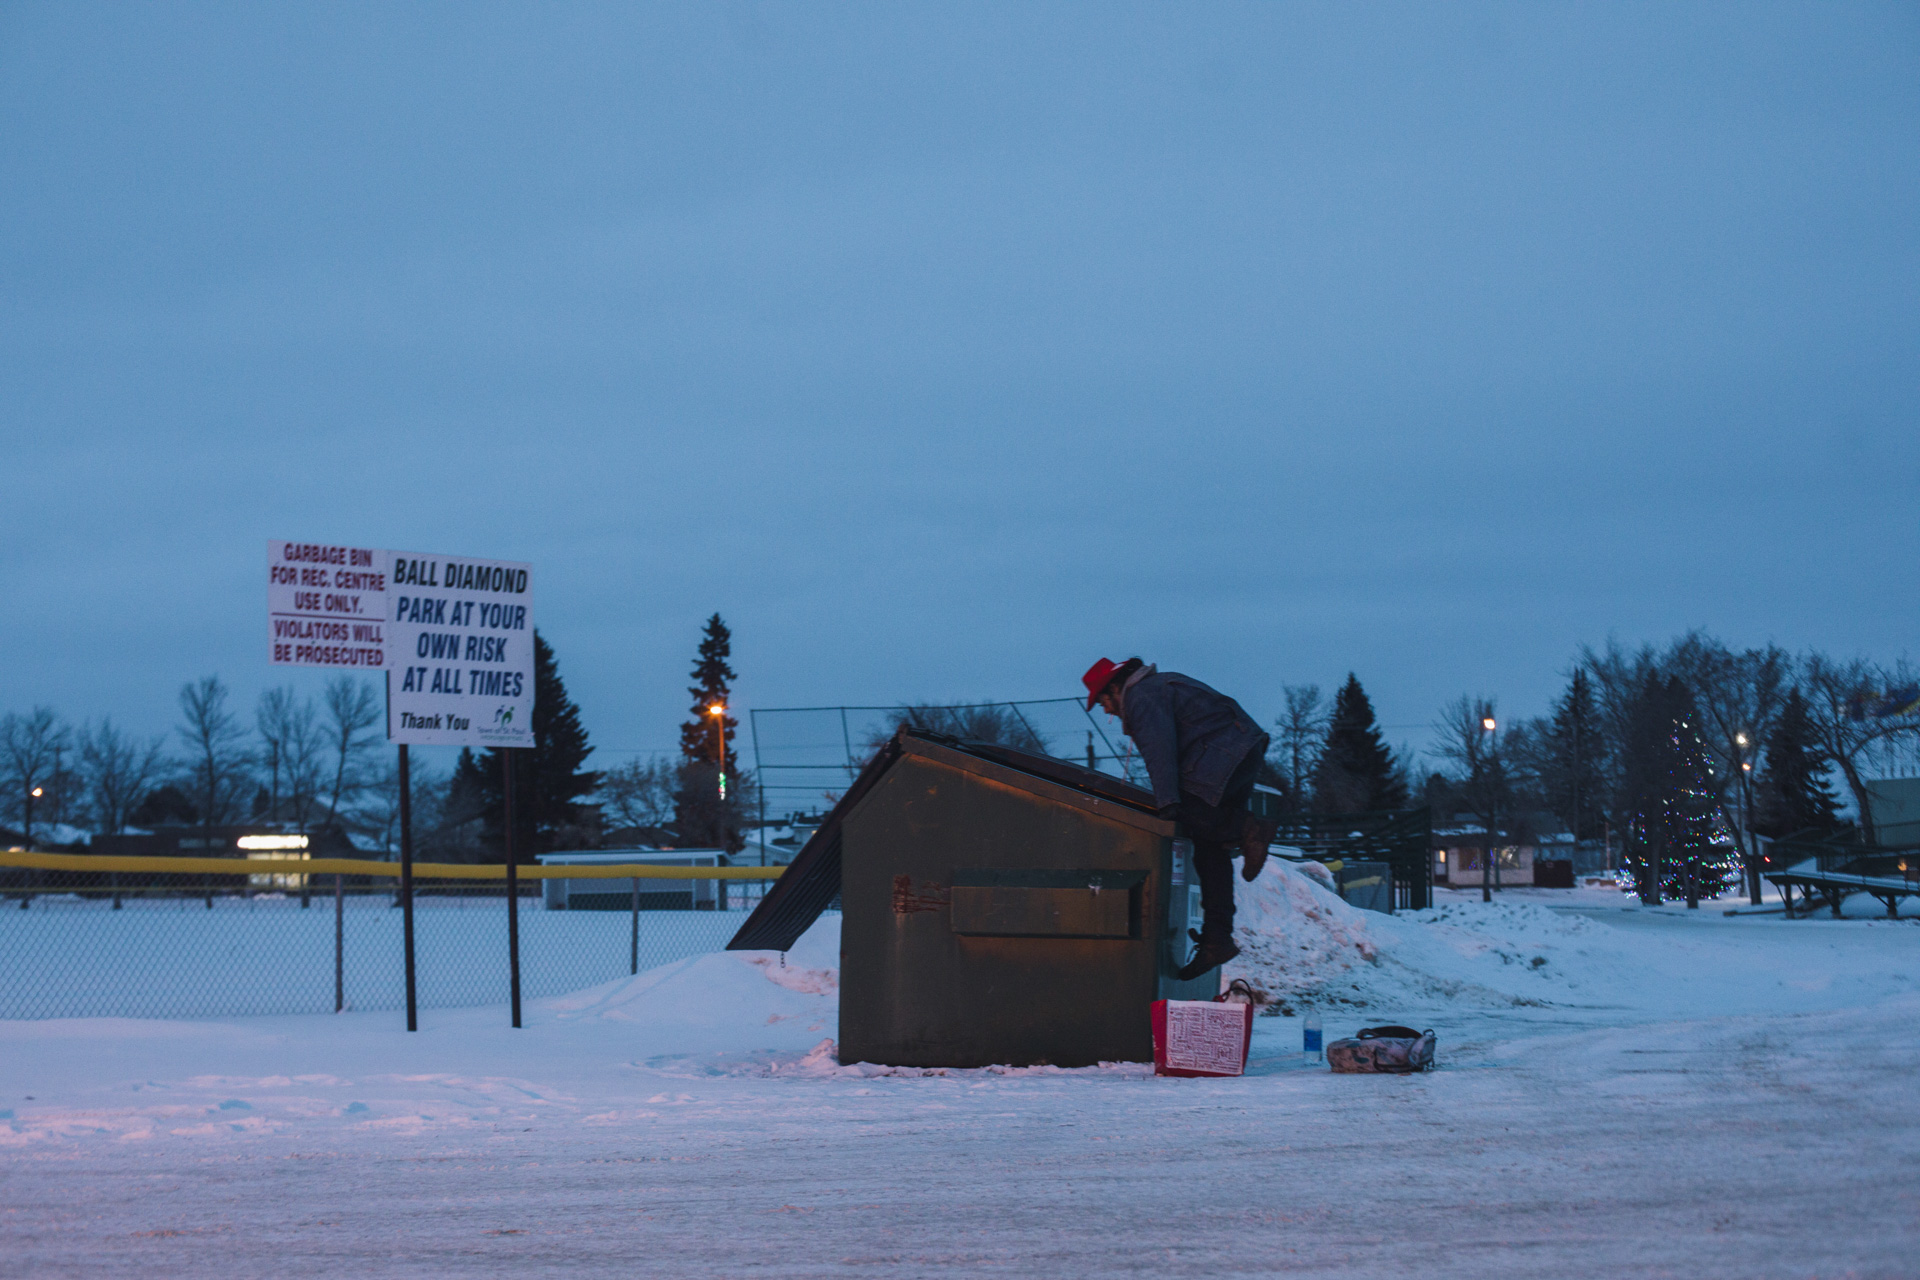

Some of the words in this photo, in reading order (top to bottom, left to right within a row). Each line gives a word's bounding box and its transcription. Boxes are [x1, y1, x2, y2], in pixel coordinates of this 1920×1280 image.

[284, 543, 346, 565] GARBAGE
[350, 549, 372, 567] BIN
[271, 566, 298, 585] FOR
[301, 569, 331, 588] REC.
[335, 571, 385, 591] CENTRE
[394, 559, 438, 586] BALL
[444, 563, 527, 593] DIAMOND
[295, 592, 321, 610] USE
[325, 594, 363, 613] ONLY.
[396, 596, 447, 625] PARK
[450, 600, 475, 627] AT
[480, 603, 526, 630] YOUR
[274, 620, 348, 641] VIOLATORS
[353, 625, 383, 643] WILL
[274, 644, 292, 661] BE
[296, 645, 383, 666] PROSECUTED
[417, 632, 461, 660] OWN
[465, 636, 508, 663] RISK
[402, 666, 427, 692] AT
[431, 668, 462, 694] ALL
[469, 670, 524, 697] TIMES
[401, 712, 443, 730] Thank
[446, 714, 470, 731] You
